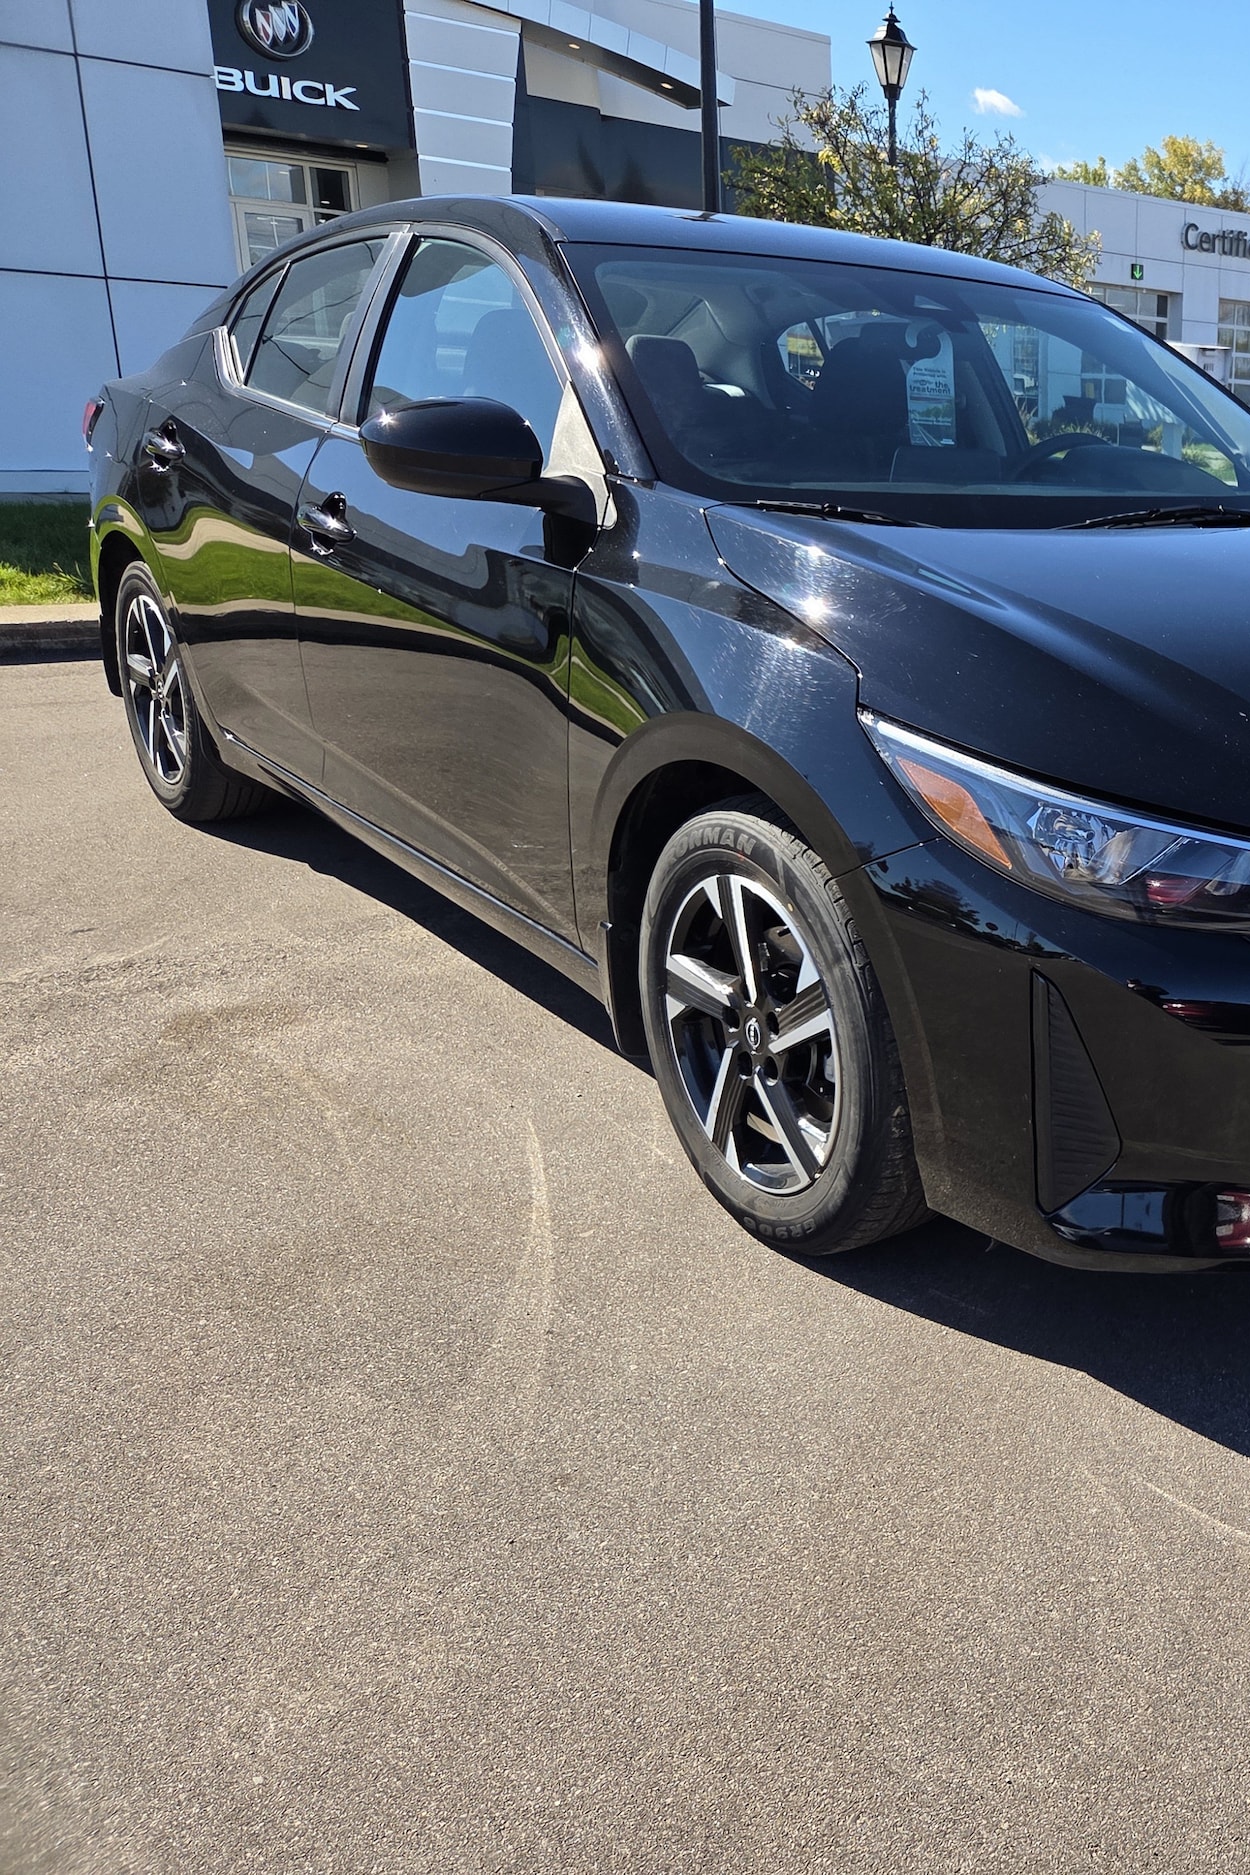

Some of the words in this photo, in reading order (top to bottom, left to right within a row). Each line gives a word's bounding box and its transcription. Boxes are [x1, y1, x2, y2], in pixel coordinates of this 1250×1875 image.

[213, 65, 361, 111] BUICK
[909, 383, 951, 395] treatment
[934, 380, 950, 389] the
